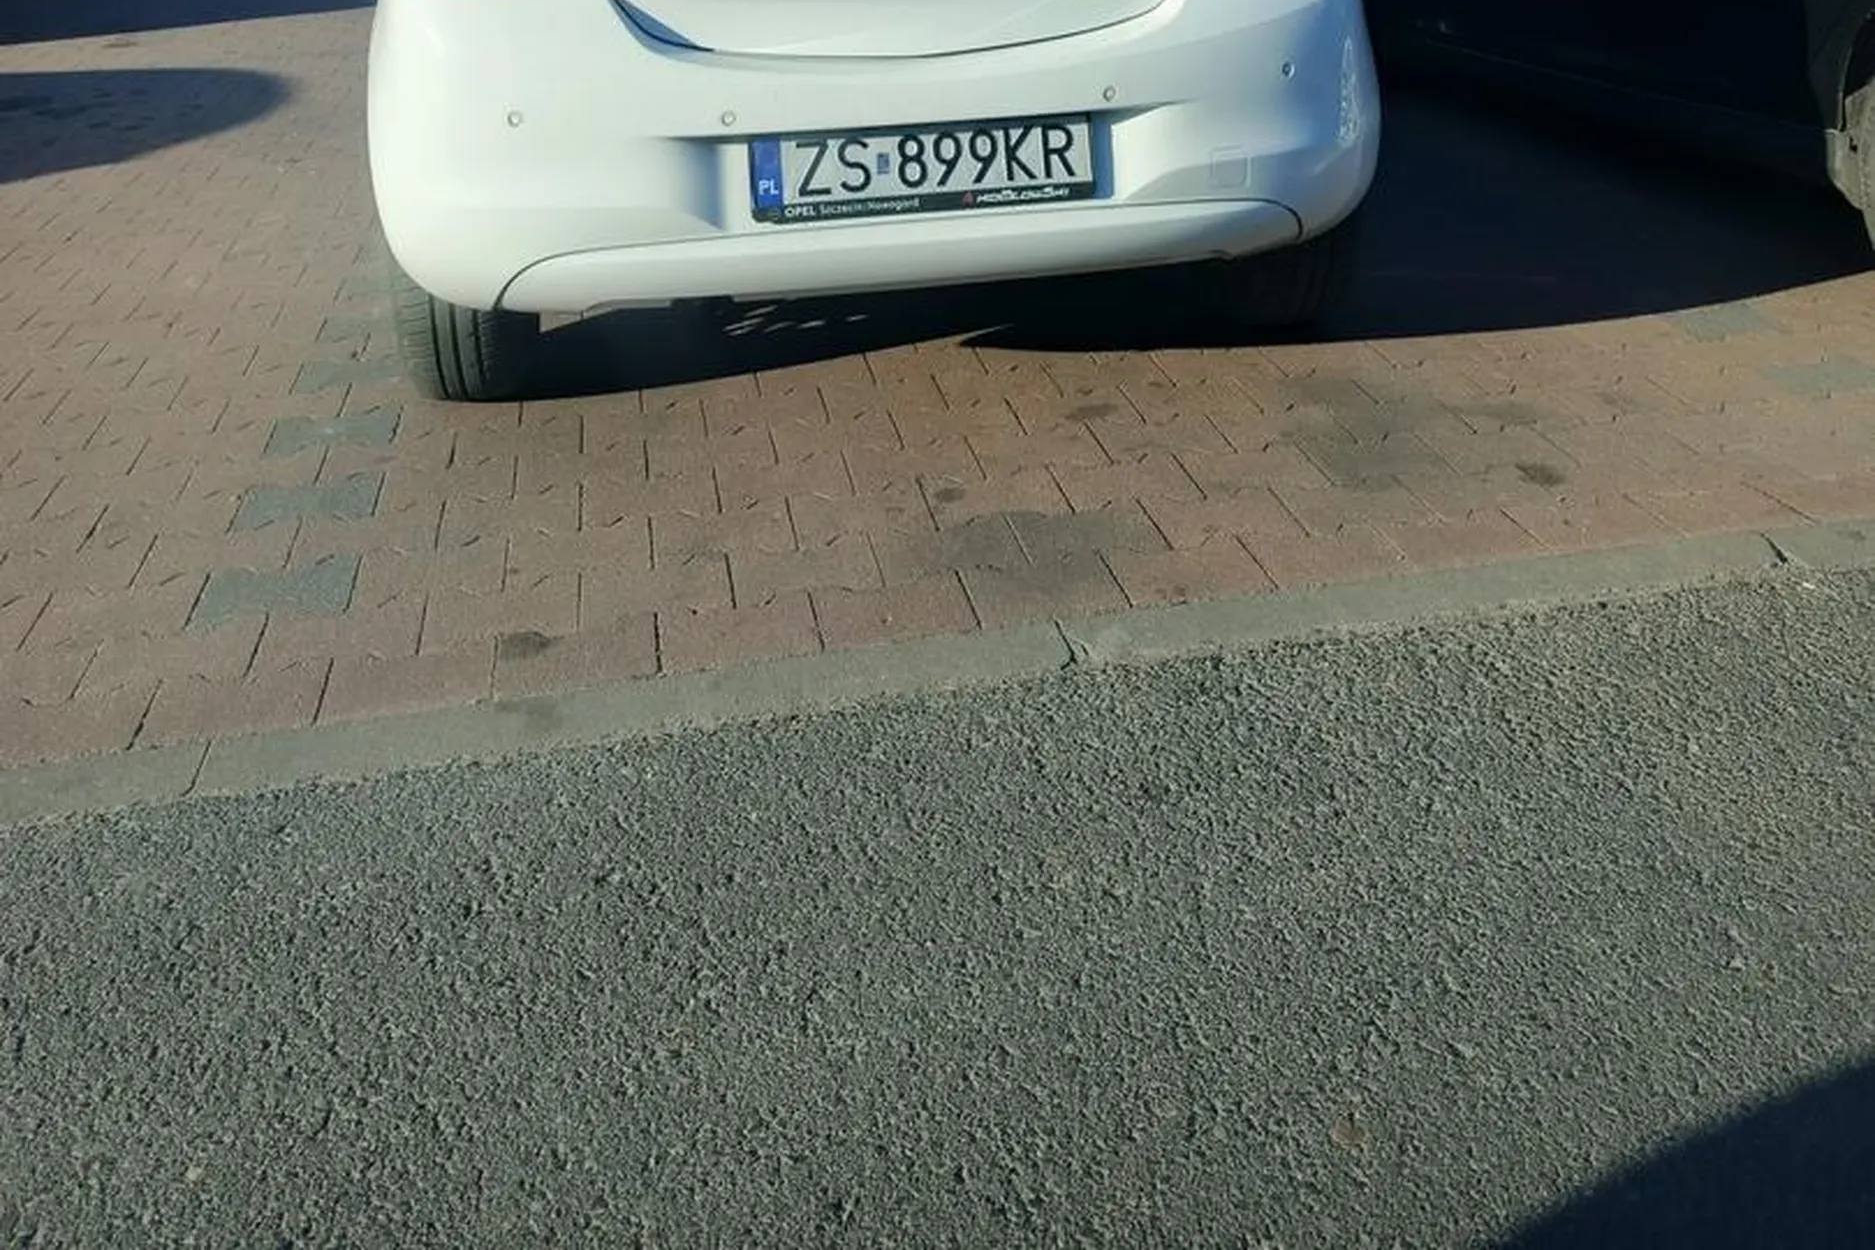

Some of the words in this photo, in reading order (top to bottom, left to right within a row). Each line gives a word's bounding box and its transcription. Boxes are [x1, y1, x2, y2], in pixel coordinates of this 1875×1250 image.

[795, 136, 872, 197] ZS
[898, 124, 1076, 188] 899KR
[758, 179, 780, 195] PL
[784, 206, 816, 217] OPEL
